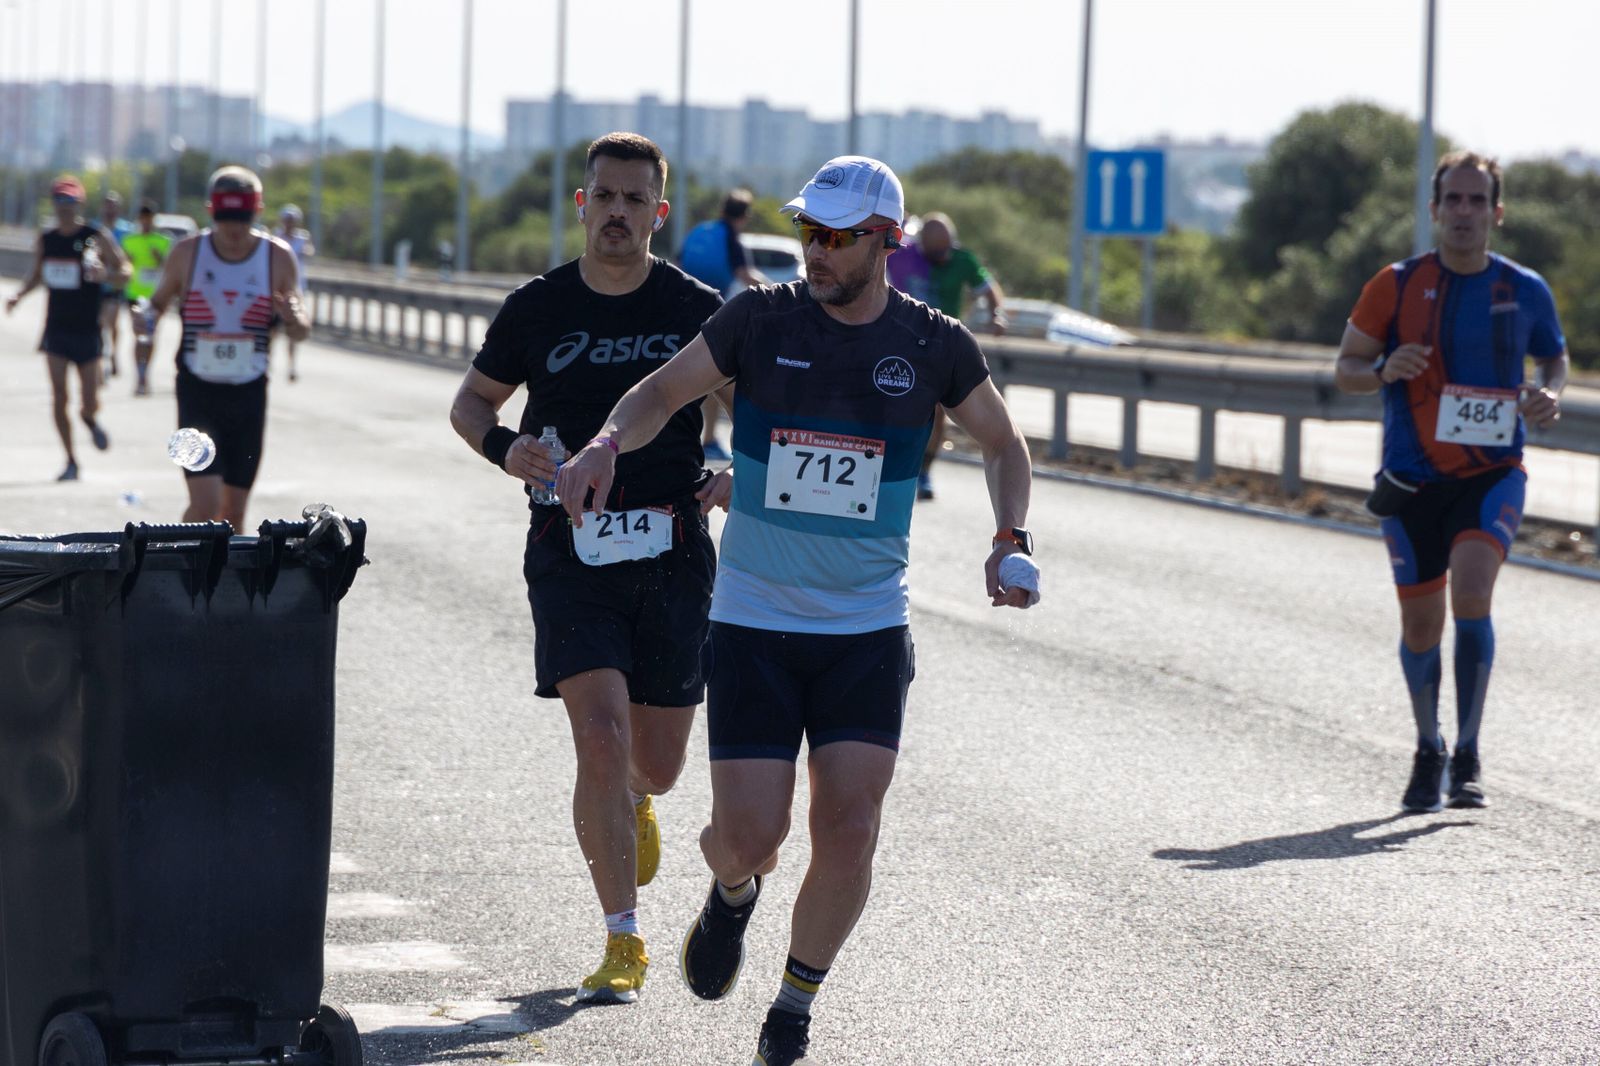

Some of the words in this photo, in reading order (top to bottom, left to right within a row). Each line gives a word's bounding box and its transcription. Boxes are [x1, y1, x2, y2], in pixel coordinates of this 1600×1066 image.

[215, 344, 237, 360] 68
[878, 378, 910, 388] DREAMS
[1457, 402, 1499, 424] 484
[814, 438, 840, 448] BAHÍA
[795, 450, 857, 486] 712
[595, 512, 651, 539] 214
